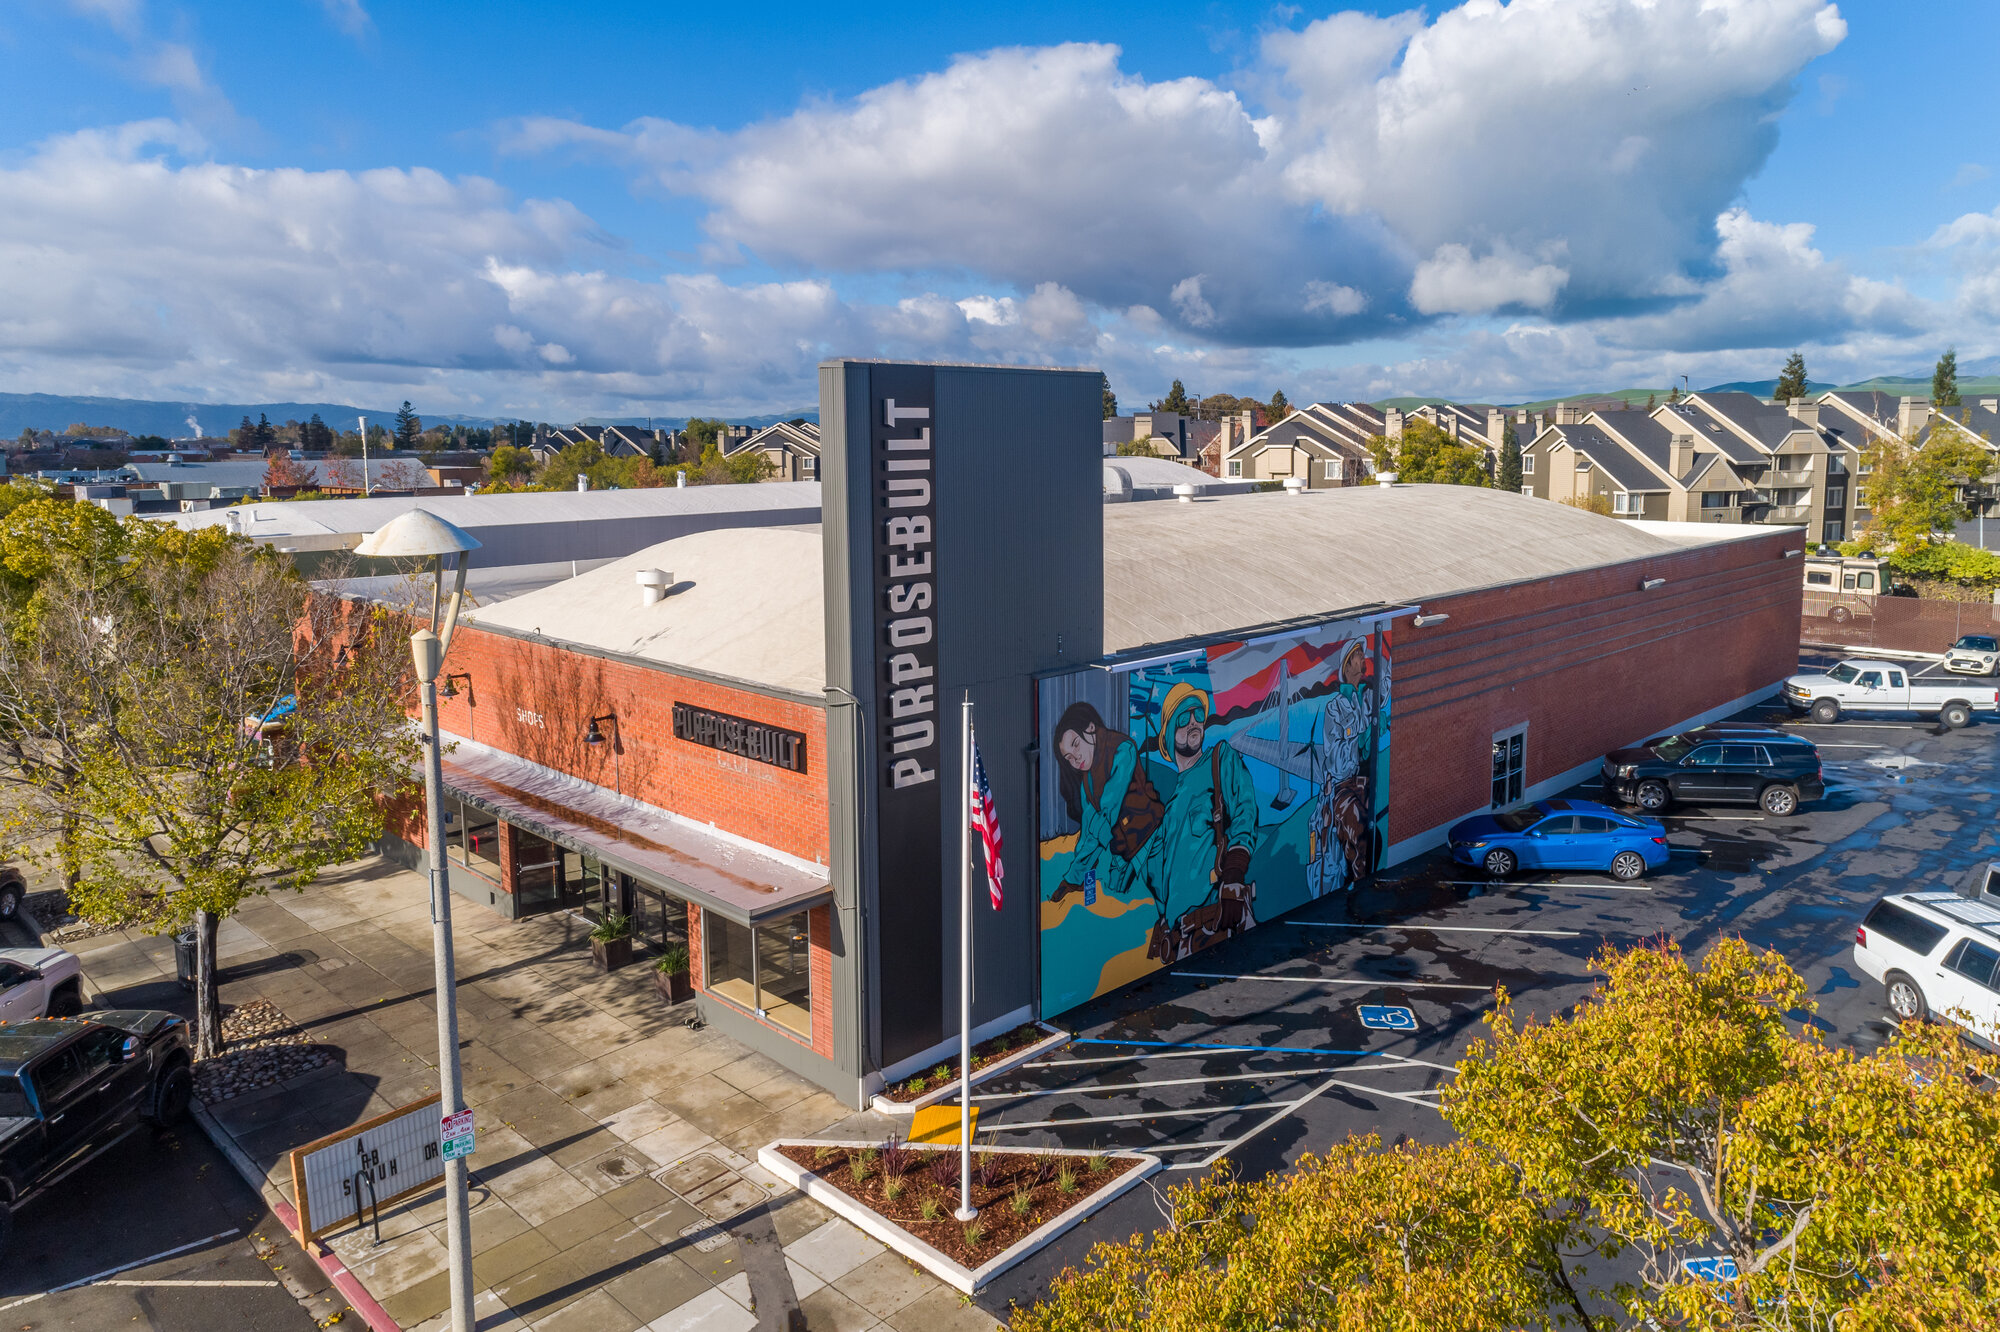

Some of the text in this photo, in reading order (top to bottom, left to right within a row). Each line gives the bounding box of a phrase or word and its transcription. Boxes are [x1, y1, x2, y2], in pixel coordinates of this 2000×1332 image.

[884, 398, 936, 790] PURPOSEBUILT
[516, 707, 545, 729] SHOPS
[442, 1120, 452, 1131] NO
[453, 1115, 471, 1127] PARKING
[357, 1138, 364, 1155] A
[455, 1139, 472, 1149] PARKING
